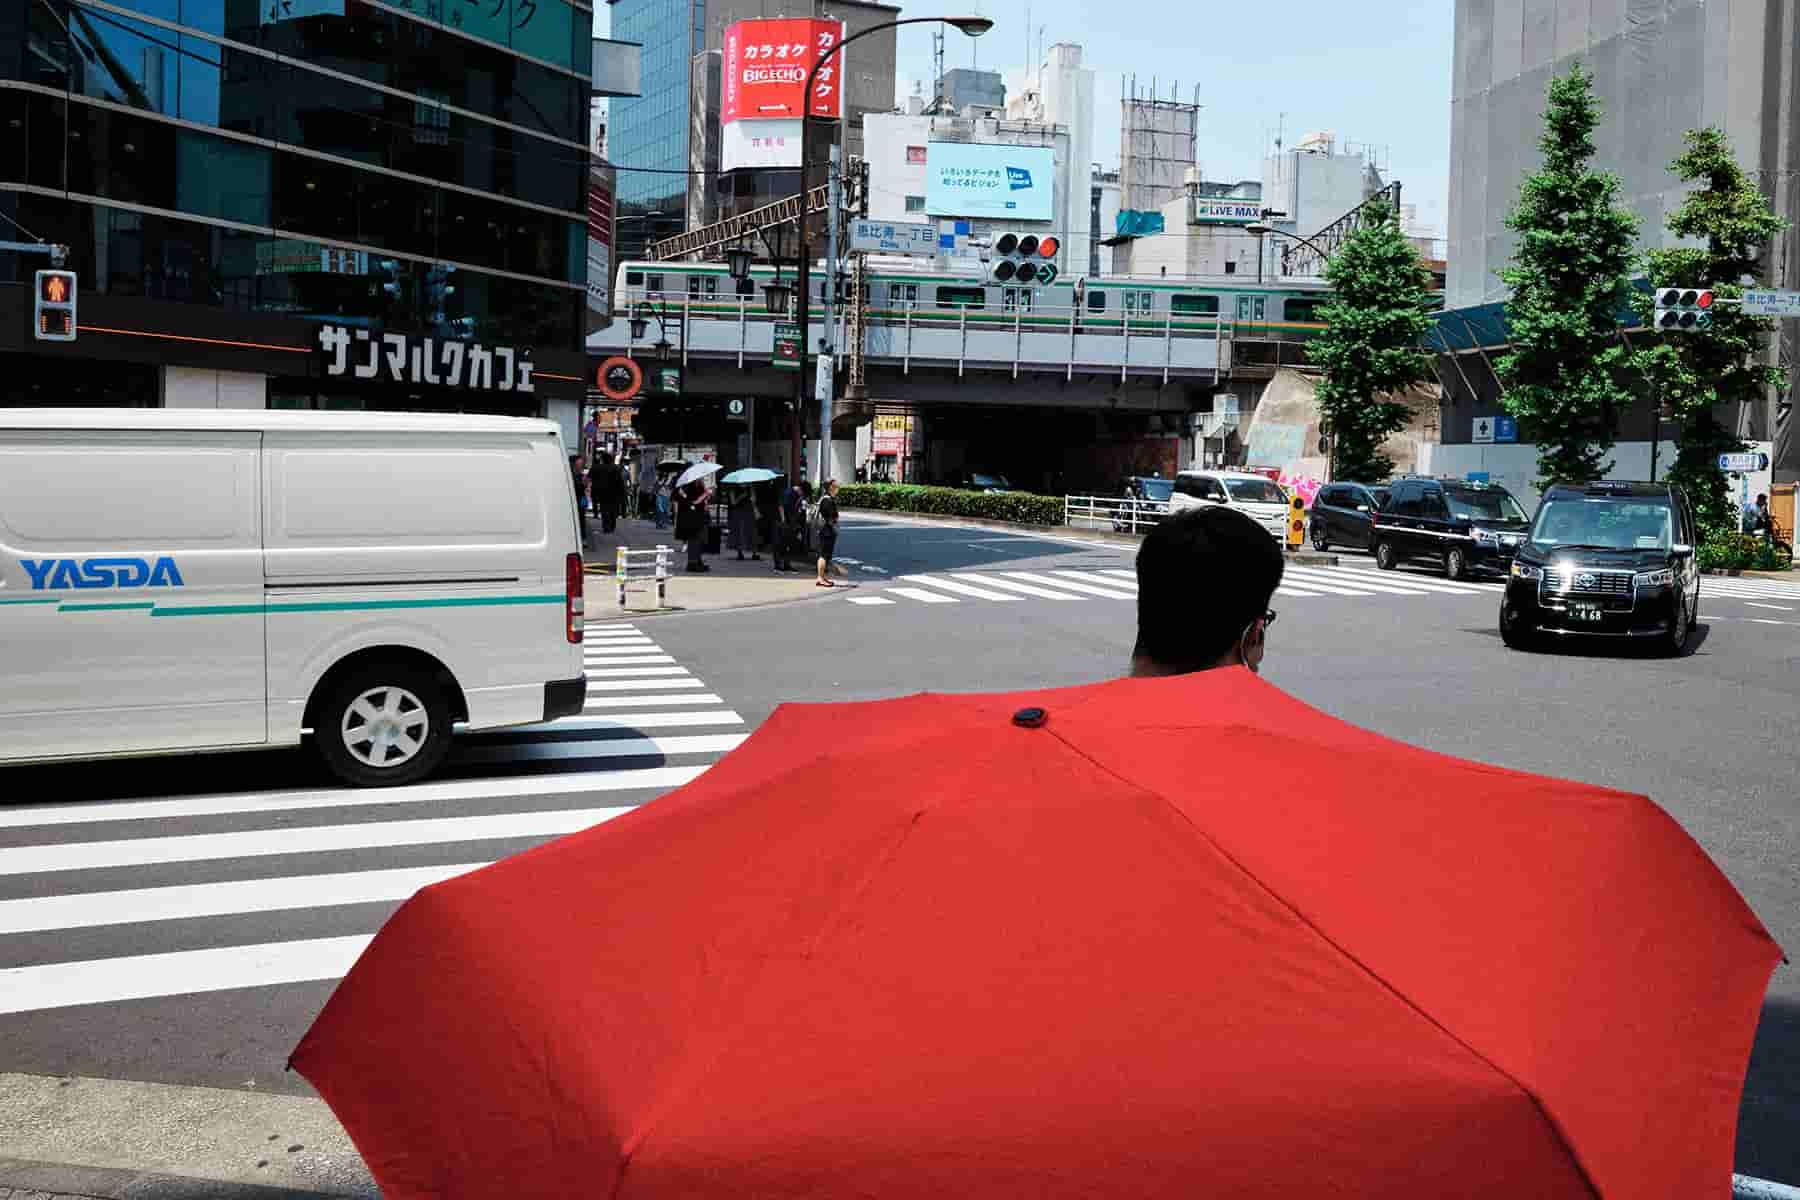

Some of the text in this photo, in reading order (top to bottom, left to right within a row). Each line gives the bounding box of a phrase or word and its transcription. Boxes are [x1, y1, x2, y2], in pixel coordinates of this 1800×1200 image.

[744, 44, 808, 59] カラオケ
[1235, 207, 1259, 217] MAX
[857, 223, 934, 241] 恵比寿一丁目
[319, 325, 535, 392] サンマルクカフェ
[19, 556, 185, 590] YASDA
